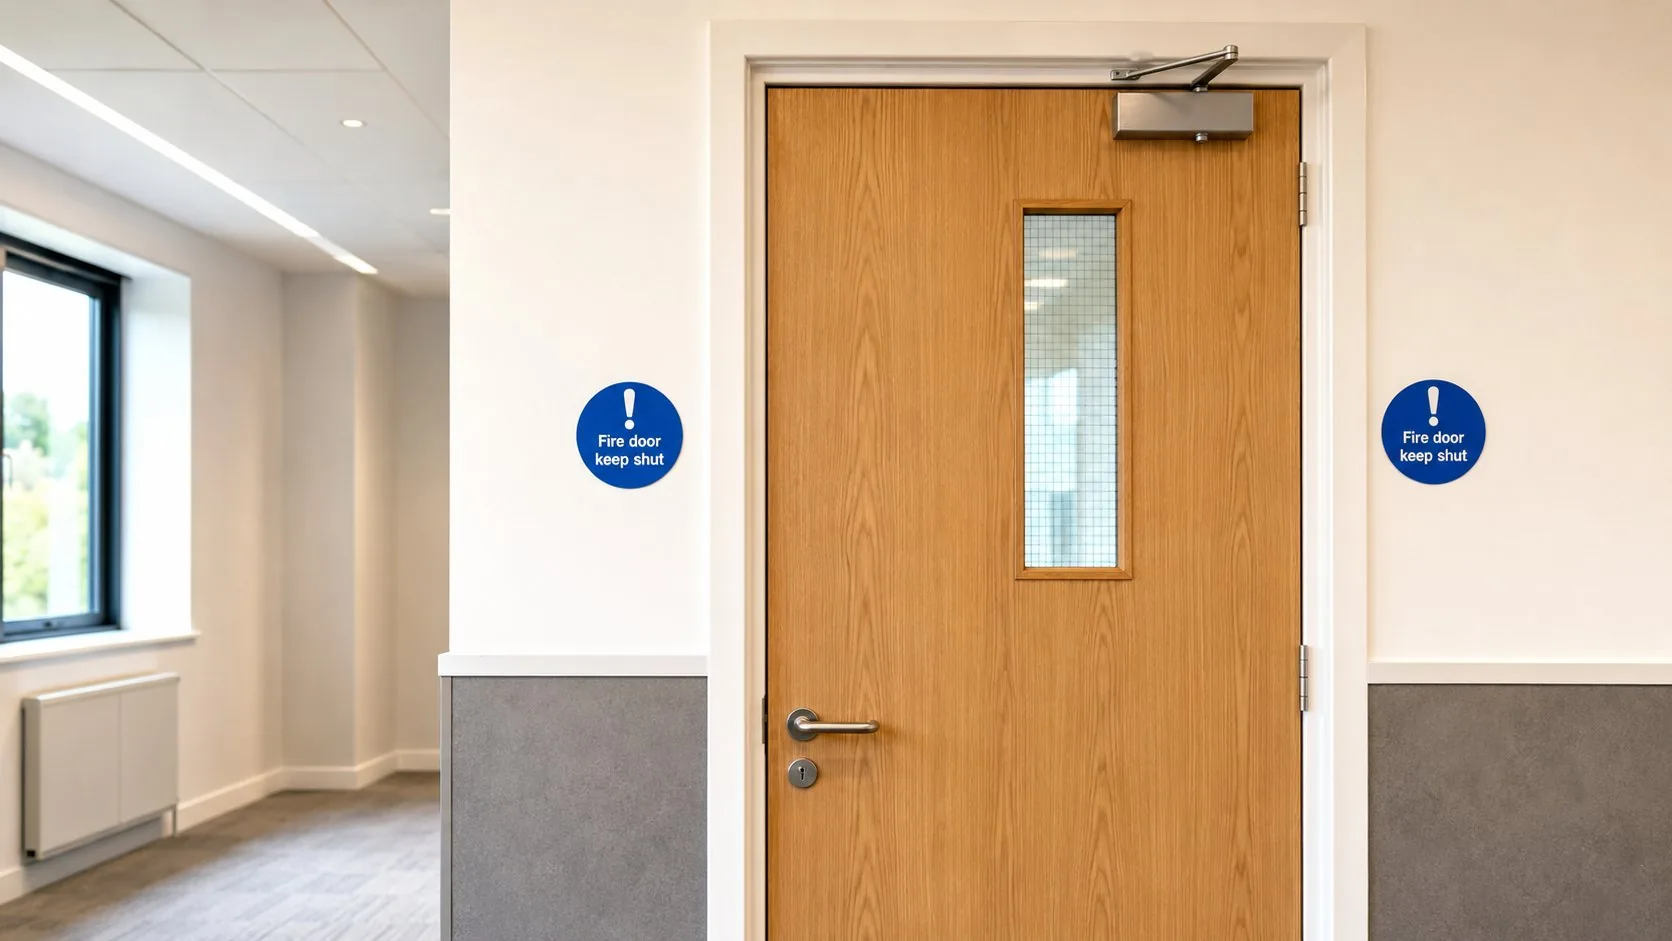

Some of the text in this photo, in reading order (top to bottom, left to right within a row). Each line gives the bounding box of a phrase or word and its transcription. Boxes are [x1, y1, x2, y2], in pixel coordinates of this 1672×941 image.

[598, 434, 662, 448] Fire door
[1403, 430, 1465, 444] Fire door
[595, 452, 665, 469] keep shut
[1400, 448, 1468, 465] keep shut
